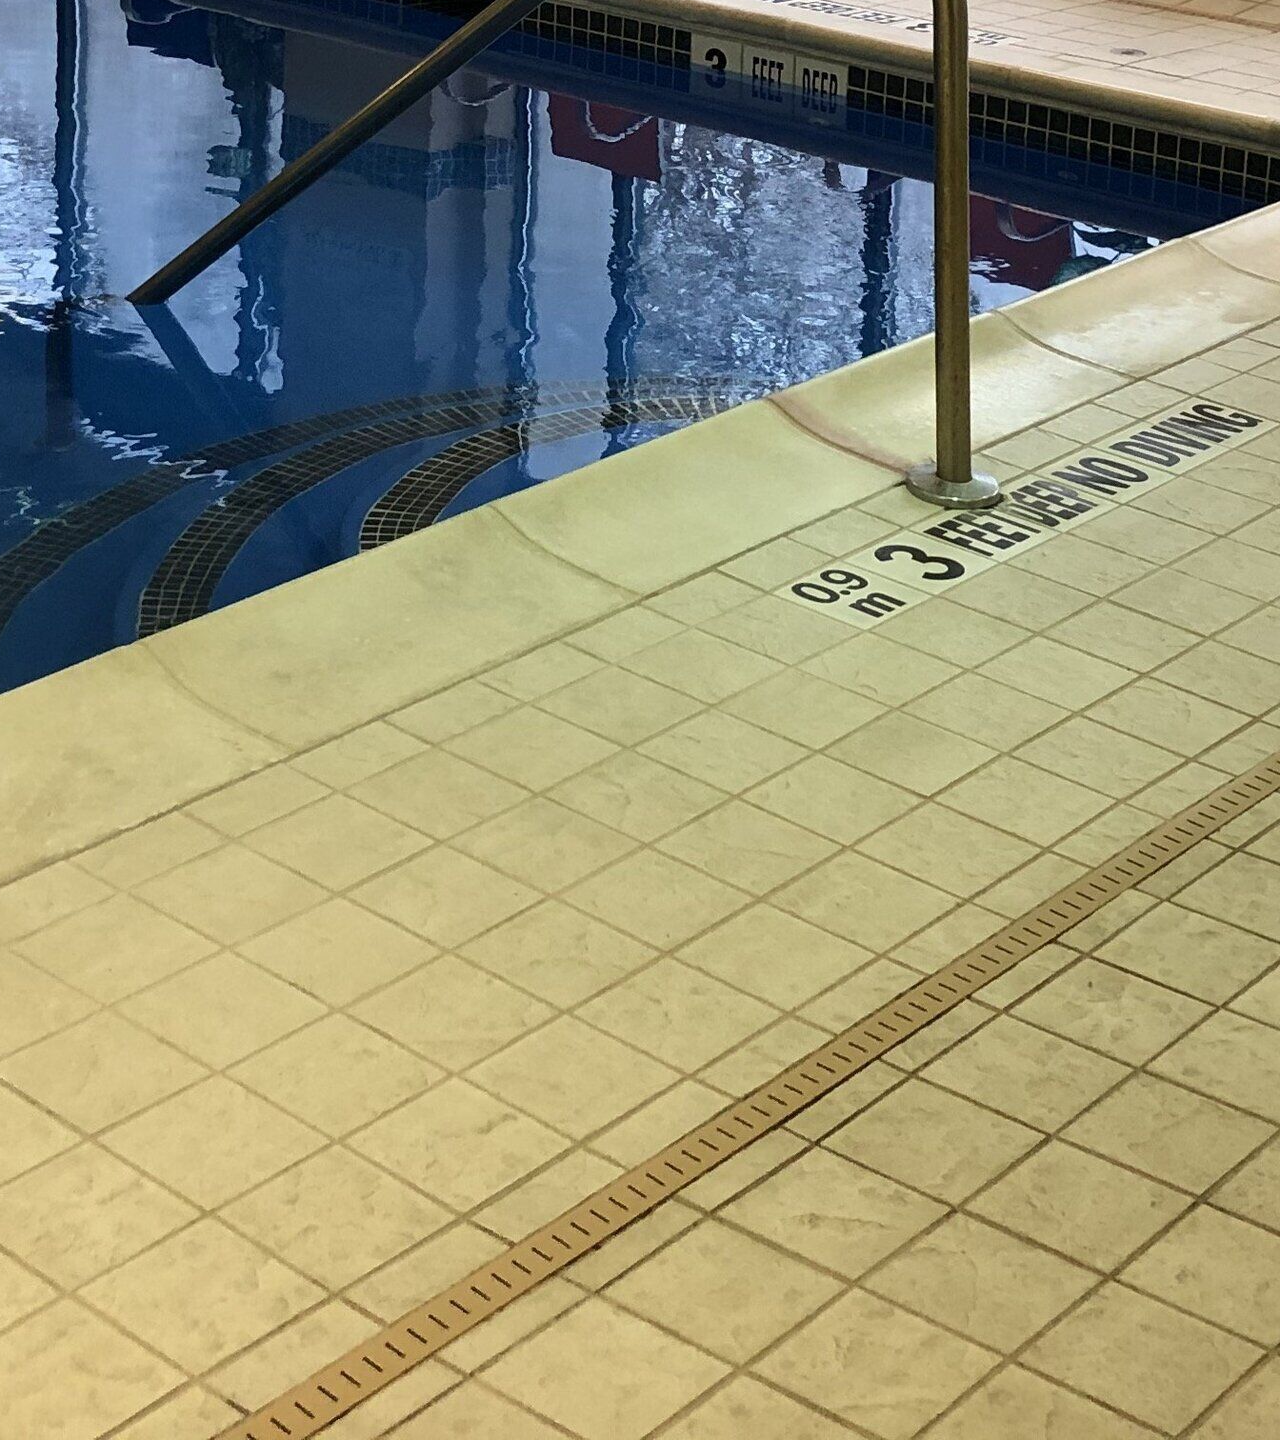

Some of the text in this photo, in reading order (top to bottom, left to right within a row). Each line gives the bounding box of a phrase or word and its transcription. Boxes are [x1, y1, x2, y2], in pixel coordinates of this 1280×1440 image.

[848, 10, 908, 24] FEET
[791, 403, 1264, 604] 0.9 3 FEET DEEP NO DIVING
[848, 591, 907, 618] m
